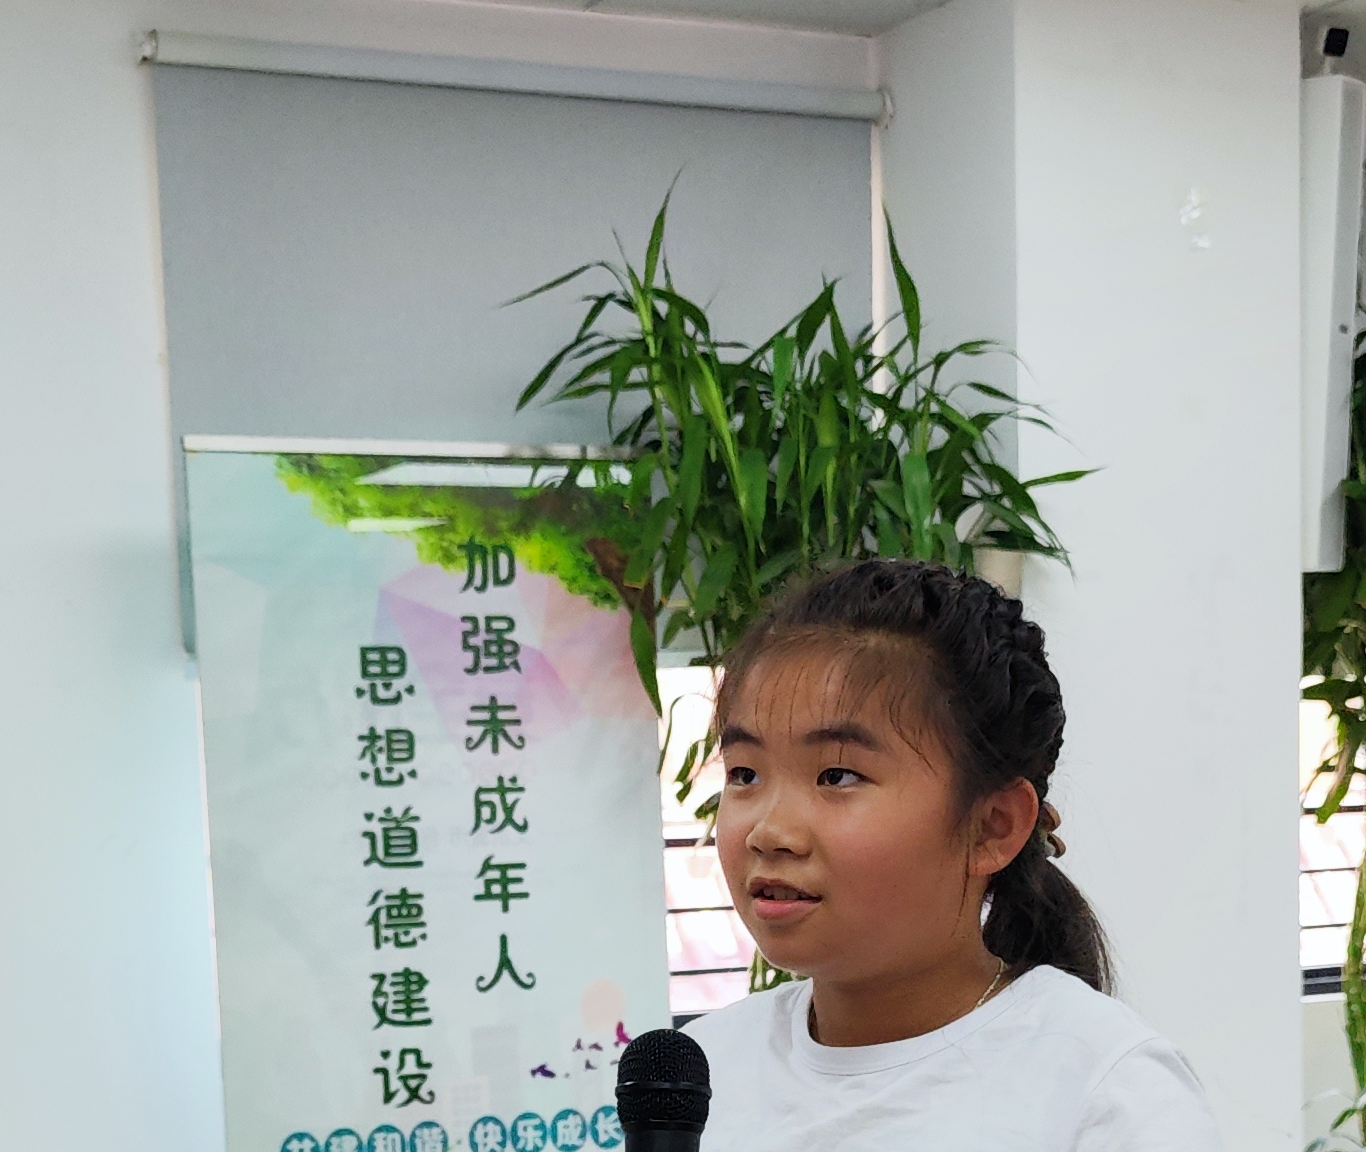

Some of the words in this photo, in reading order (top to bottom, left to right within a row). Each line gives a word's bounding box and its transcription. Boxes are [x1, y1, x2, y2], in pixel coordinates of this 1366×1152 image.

[354, 644, 436, 1108] 思想道德建设
[457, 534, 537, 994] 加强未成年人
